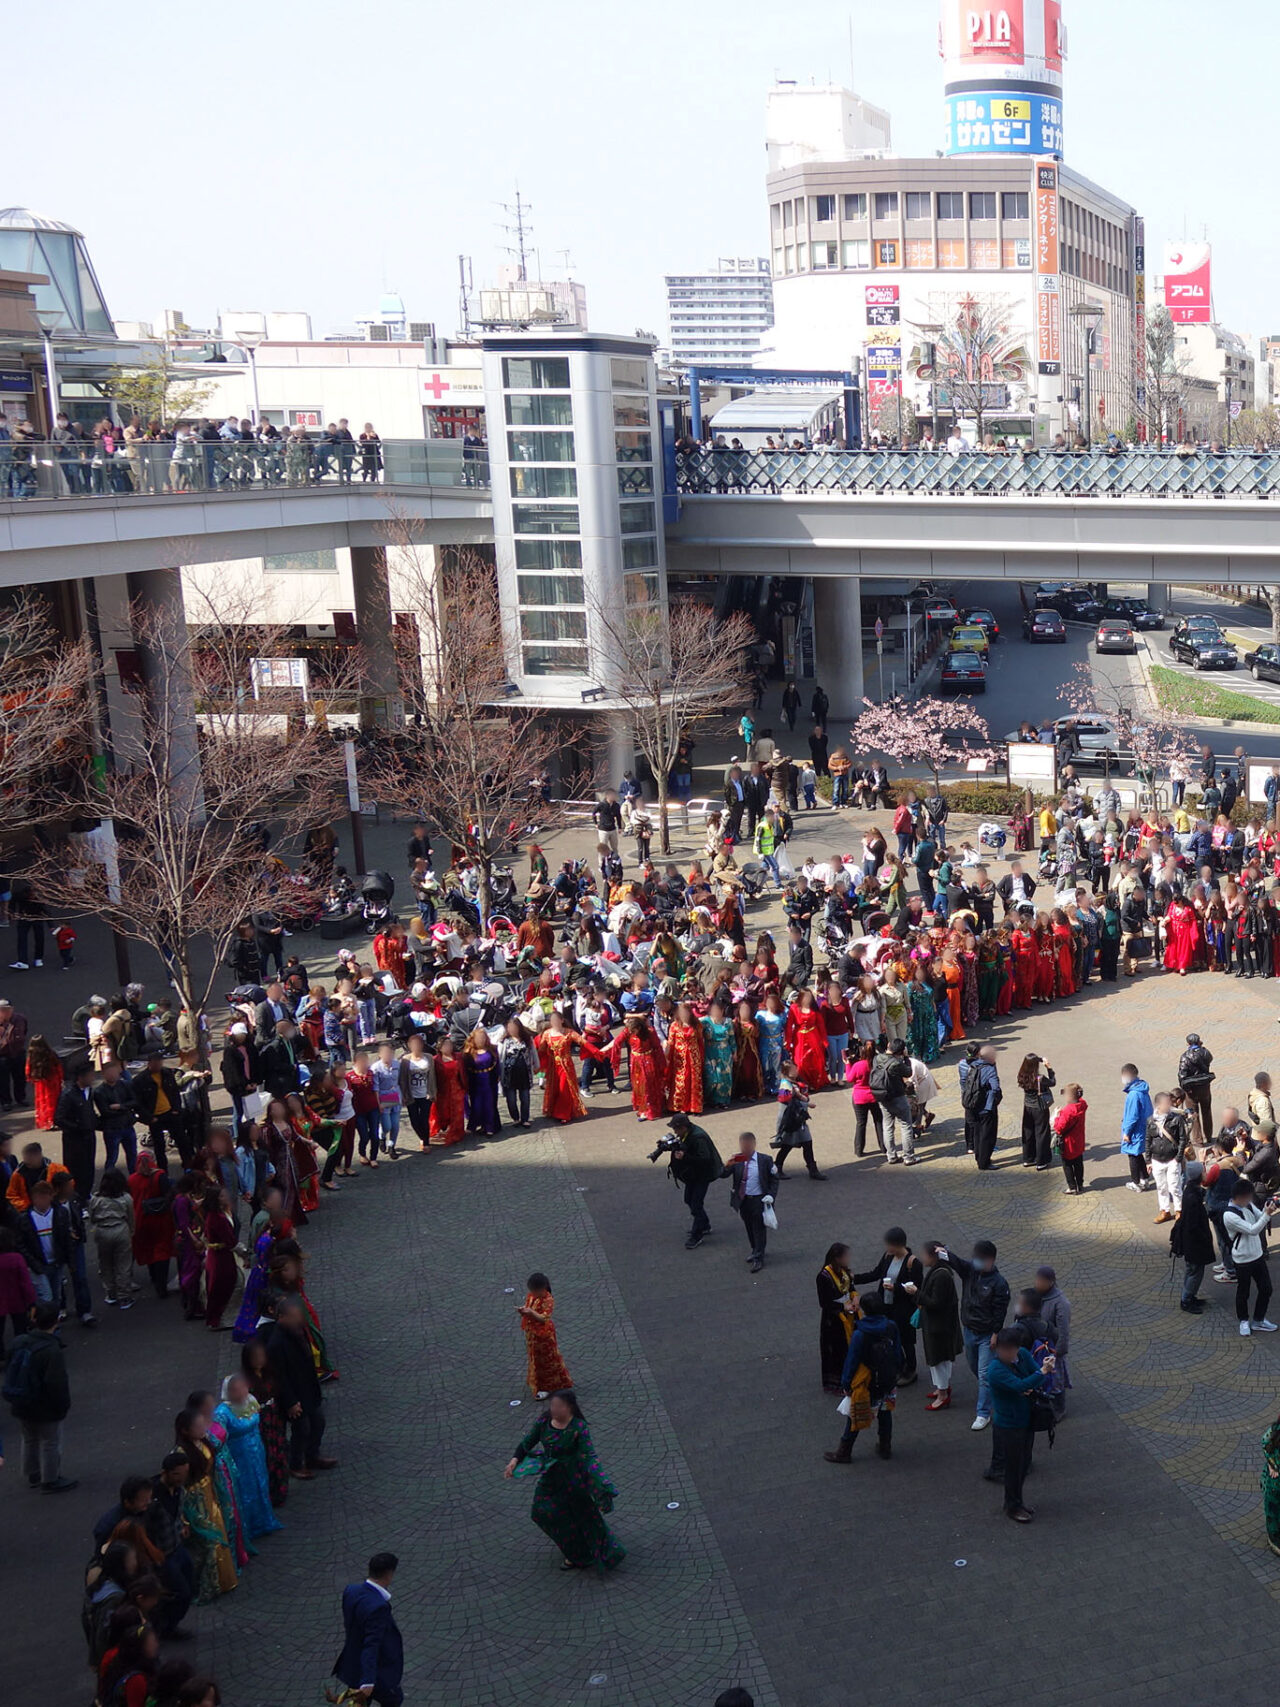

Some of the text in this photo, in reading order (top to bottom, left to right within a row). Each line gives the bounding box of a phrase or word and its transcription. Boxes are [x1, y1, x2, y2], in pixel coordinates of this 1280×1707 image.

[967, 10, 1011, 41] PIA
[1003, 102, 1018, 117] 6F
[957, 121, 1031, 146] サカゼン
[1048, 195, 1056, 236] コミック
[1039, 194, 1048, 264] インターネット
[1170, 285, 1204, 297] アコム
[1040, 294, 1048, 325] カラオケ
[1181, 310, 1194, 319] 1F
[1046, 364, 1056, 373] 7F
